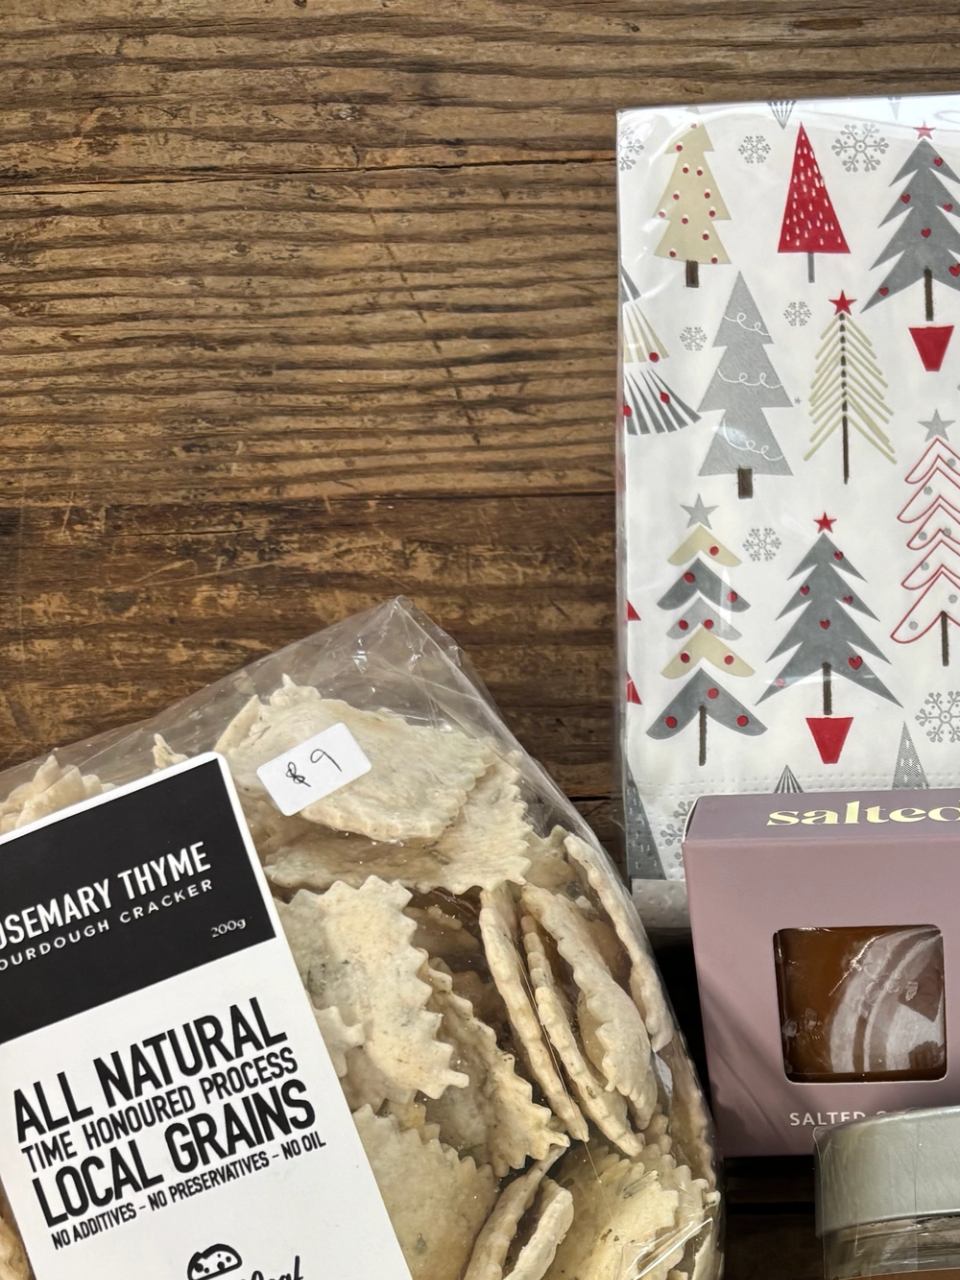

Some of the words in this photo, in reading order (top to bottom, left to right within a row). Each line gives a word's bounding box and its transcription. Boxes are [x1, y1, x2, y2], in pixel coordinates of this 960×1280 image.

[0, 878, 112, 950] SEMARY
[118, 841, 212, 900] THYME
[0, 919, 110, 971] OURDOUGH
[120, 878, 214, 925] CRACKER
[210, 917, 247, 939] 200g
[14, 1071, 95, 1144] ALL
[93, 997, 289, 1108] NATURAL
[21, 1130, 78, 1173] TIME
[82, 1085, 197, 1151] HONOURED
[199, 1046, 299, 1104] PROCESS
[32, 1139, 165, 1228] LOCAL
[164, 1079, 316, 1174] GRAINS
[51, 1229, 72, 1251] NO
[72, 1202, 137, 1243] ADDITIVES
[147, 1190, 168, 1213] NO
[169, 1151, 270, 1204] PRESERVATIVES
[280, 1138, 302, 1161] NO
[302, 1130, 327, 1153] OIL
